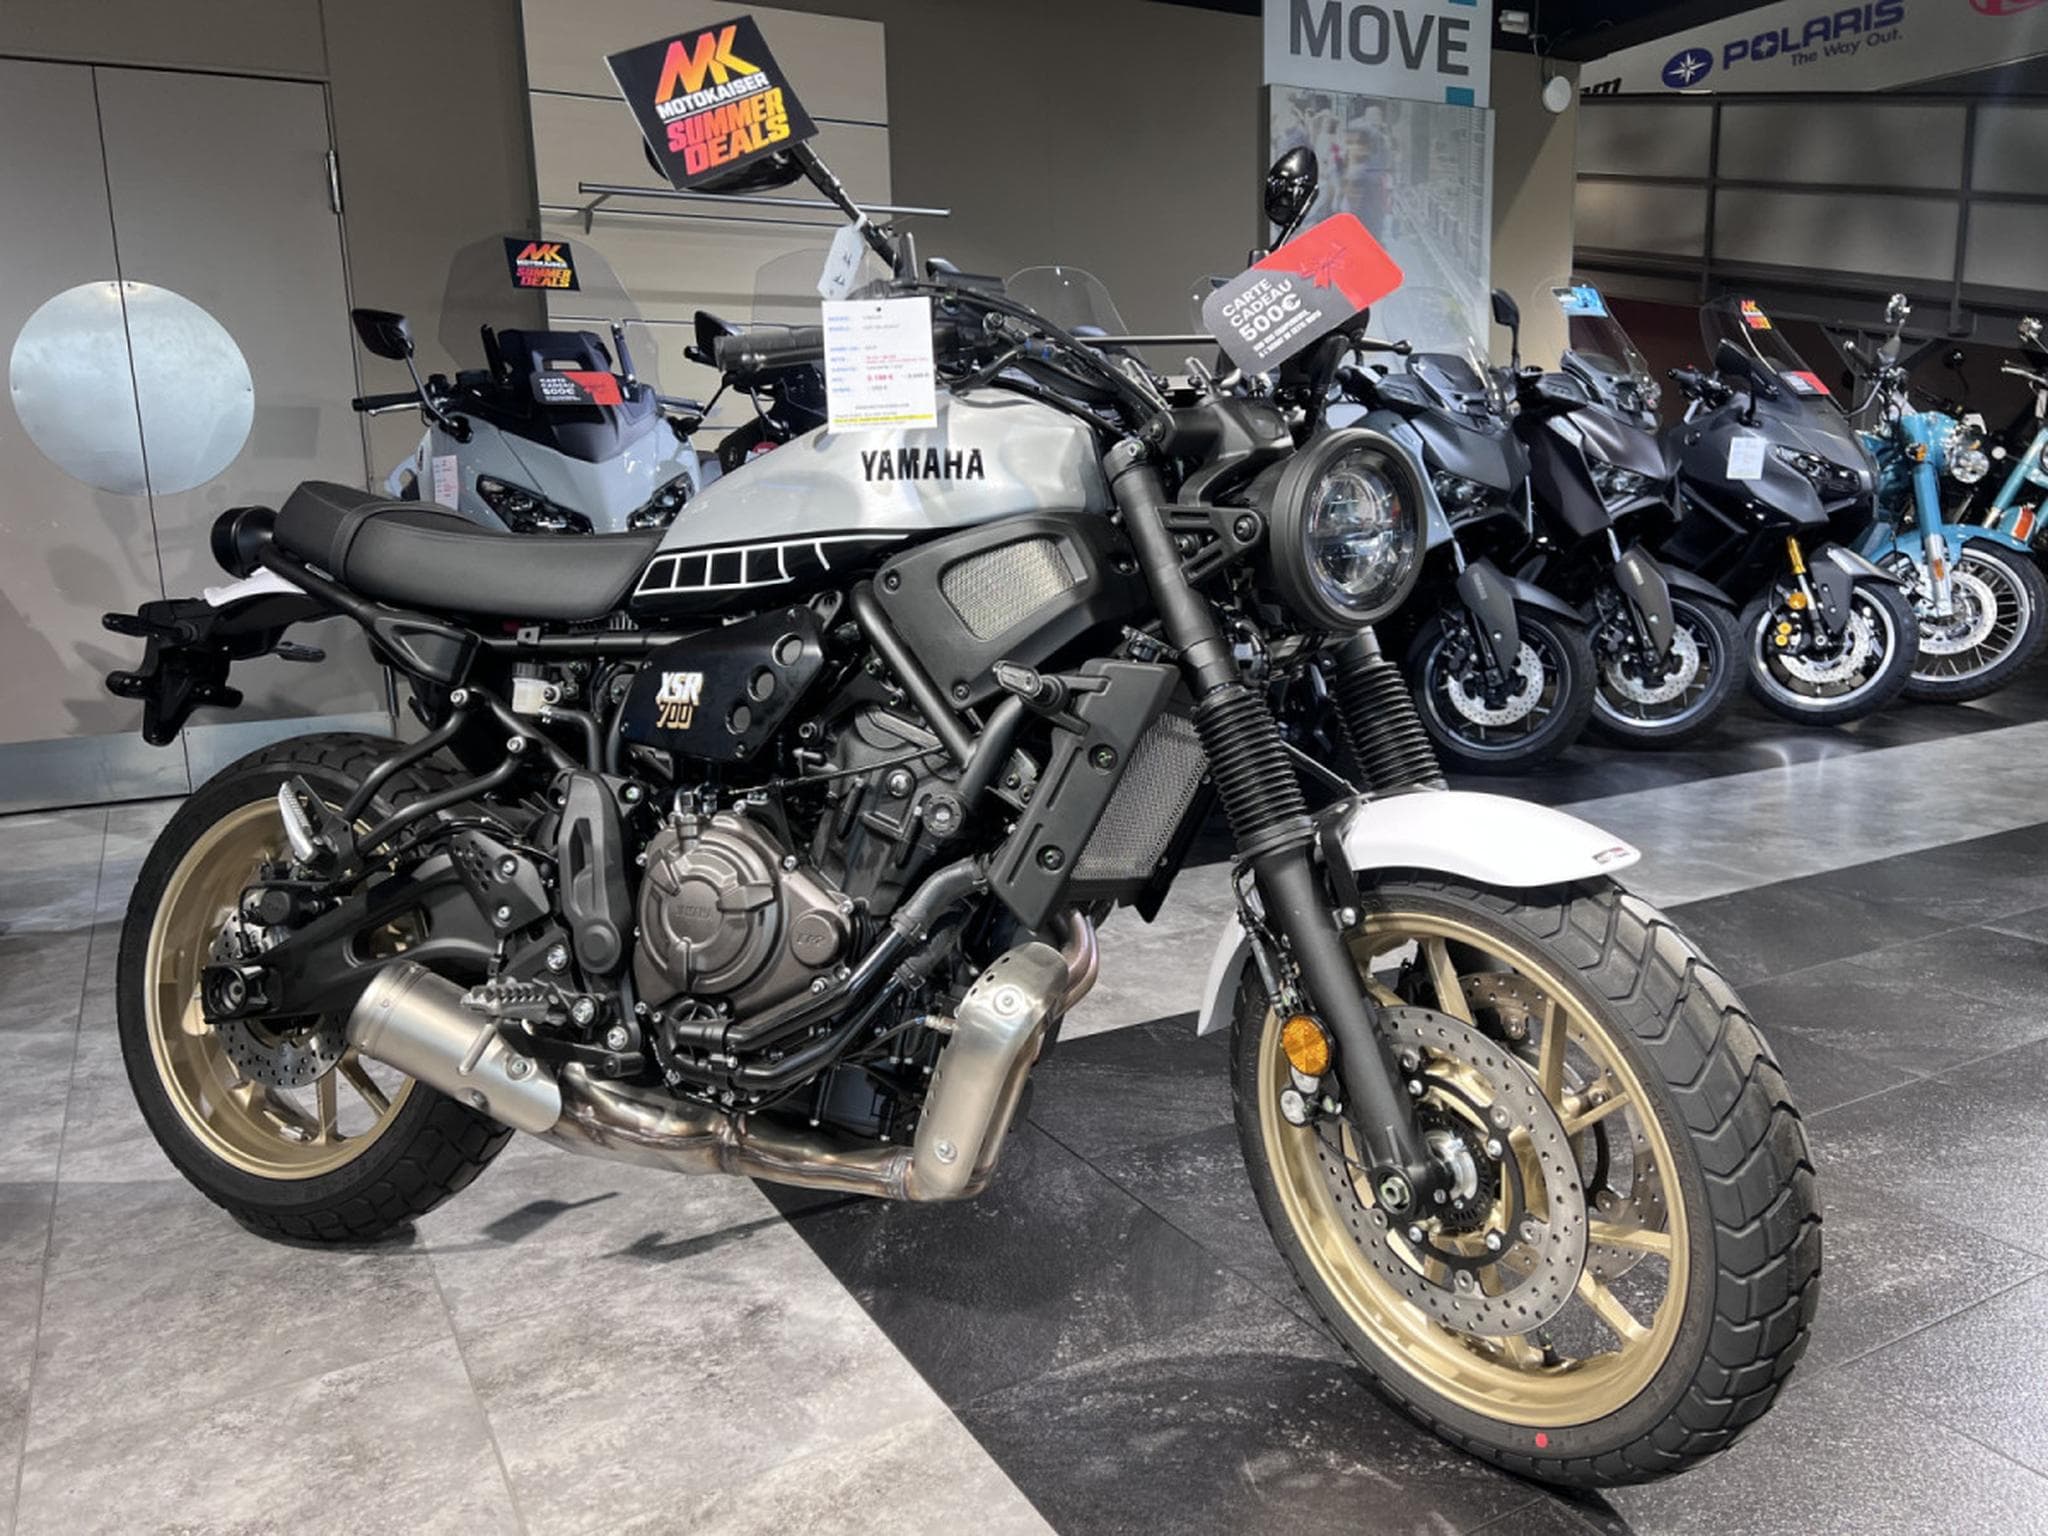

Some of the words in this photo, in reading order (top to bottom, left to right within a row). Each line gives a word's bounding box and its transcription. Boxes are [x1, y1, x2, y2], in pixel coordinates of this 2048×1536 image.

[1290, 0, 1470, 76] MOVE
[1723, 0, 1905, 70] POLARIS
[1791, 52, 1818, 66] The
[1824, 39, 1861, 56] Way
[1866, 29, 1903, 47] Out.
[655, 25, 761, 104] MK
[655, 71, 770, 120] MOTOKAISER
[666, 86, 787, 153] SUMMER
[684, 113, 791, 175] DEALS
[1222, 278, 1272, 316] CARTE
[1230, 279, 1292, 327] CADEAU
[1238, 293, 1301, 342] 500€
[861, 448, 985, 481] YAMAHA
[655, 672, 704, 706] XSR
[656, 702, 693, 729] 700
